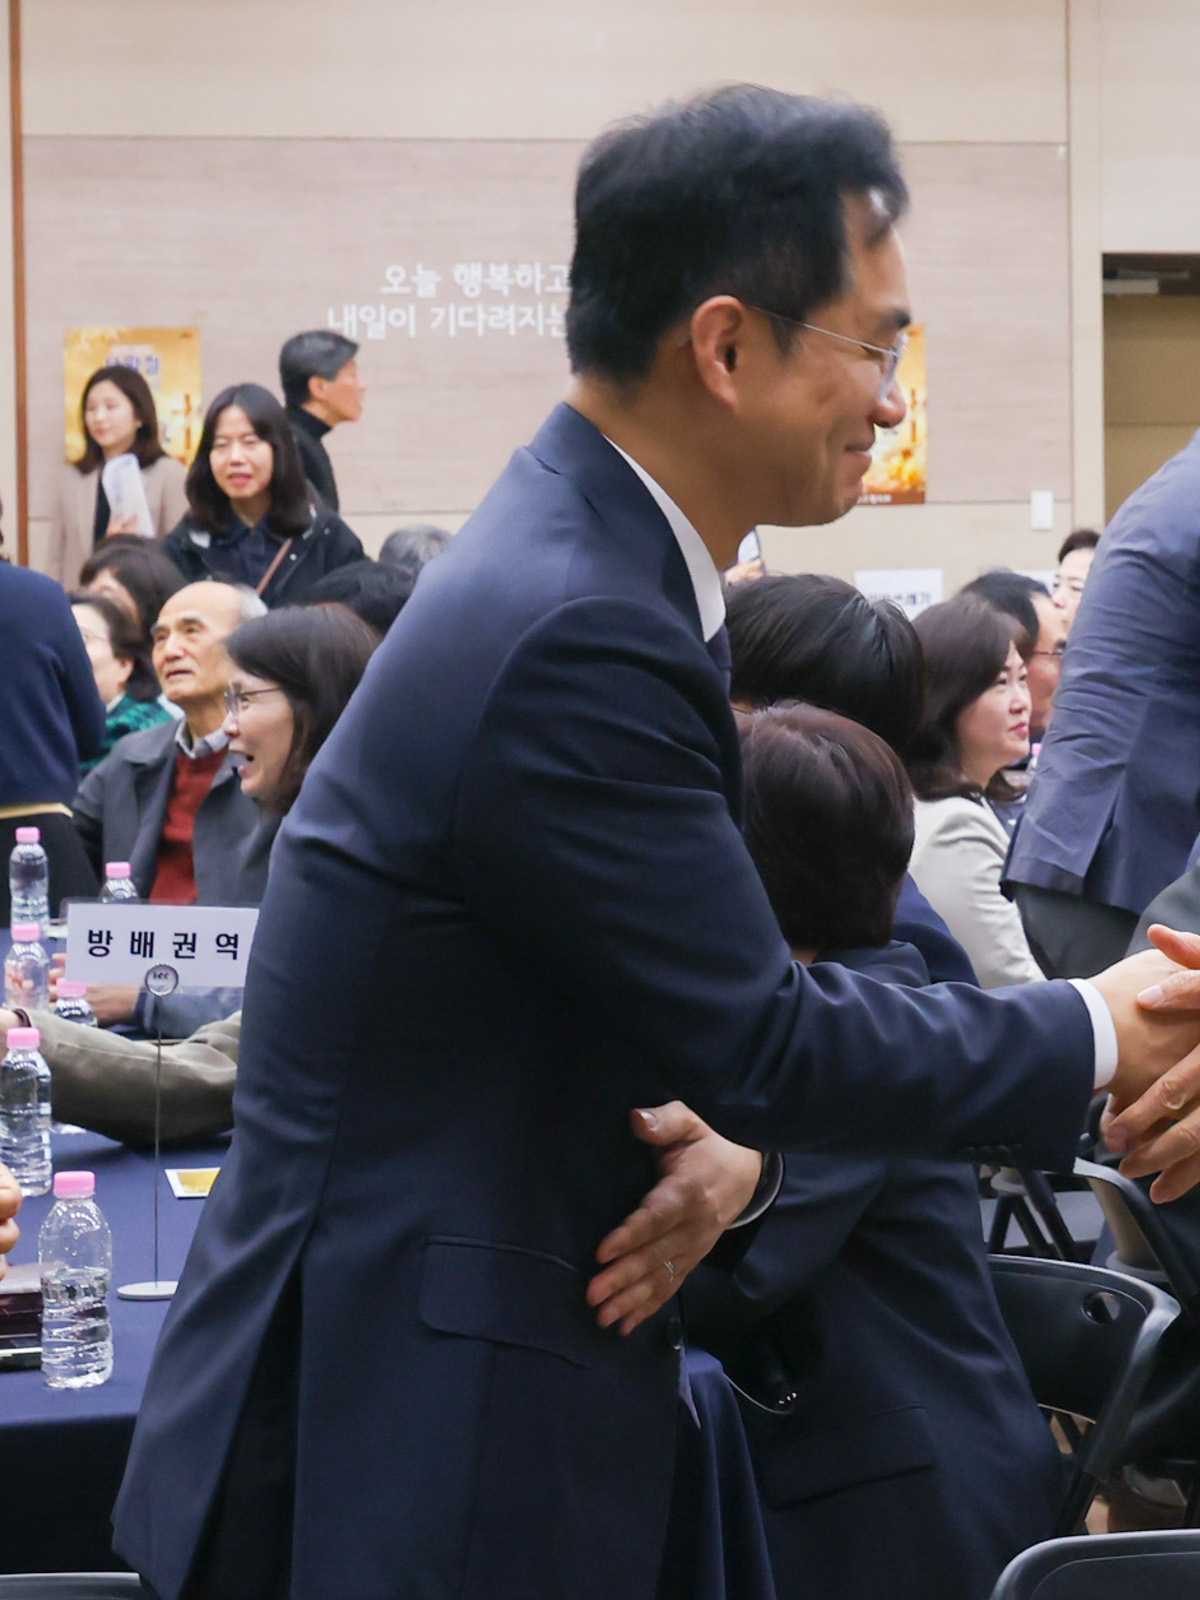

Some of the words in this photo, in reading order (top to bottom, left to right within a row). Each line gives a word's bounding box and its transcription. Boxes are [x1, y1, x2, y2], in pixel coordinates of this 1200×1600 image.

[380, 263, 442, 298] 오늘
[453, 262, 571, 298] 행복하고
[327, 303, 416, 340] 내일이
